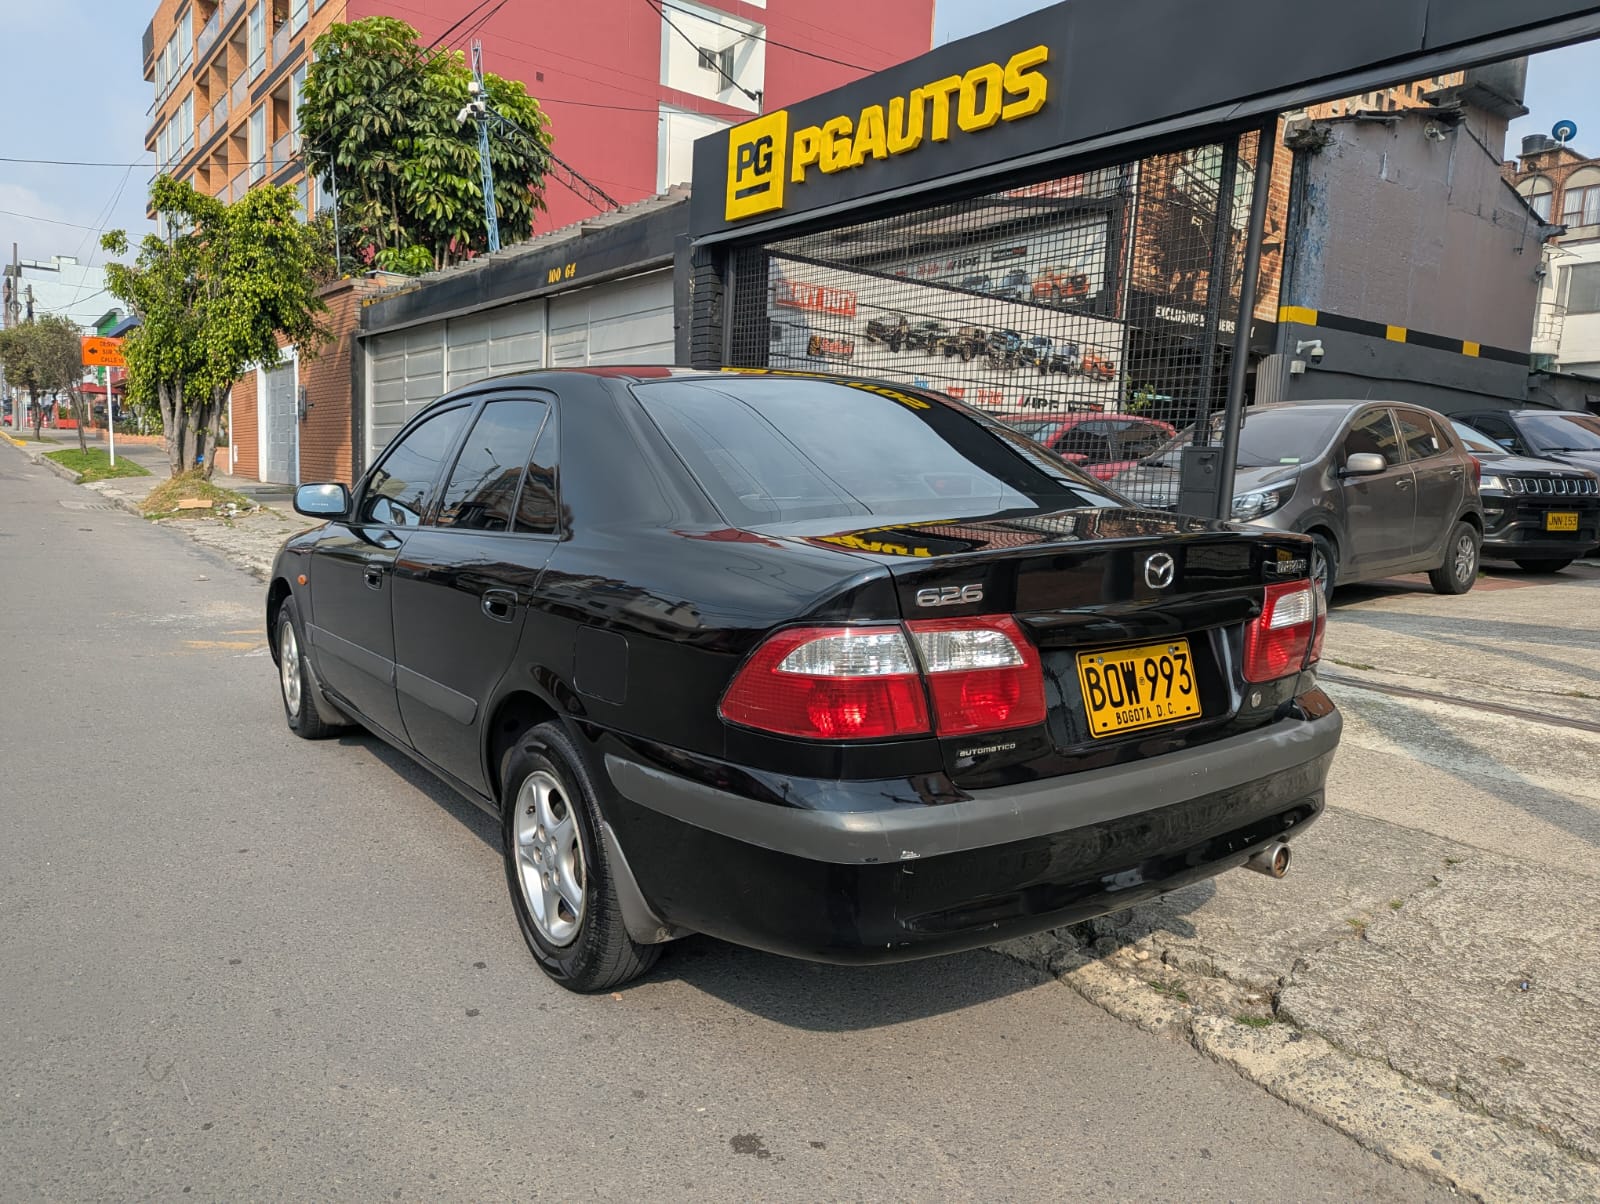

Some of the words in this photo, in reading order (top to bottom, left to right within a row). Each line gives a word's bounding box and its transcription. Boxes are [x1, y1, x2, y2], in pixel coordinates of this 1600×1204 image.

[736, 134, 773, 183] PG
[916, 583, 984, 607] 626
[1084, 660, 1141, 712] BOW
[1143, 653, 1192, 702] 993
[1115, 706, 1152, 725] BOGOTA
